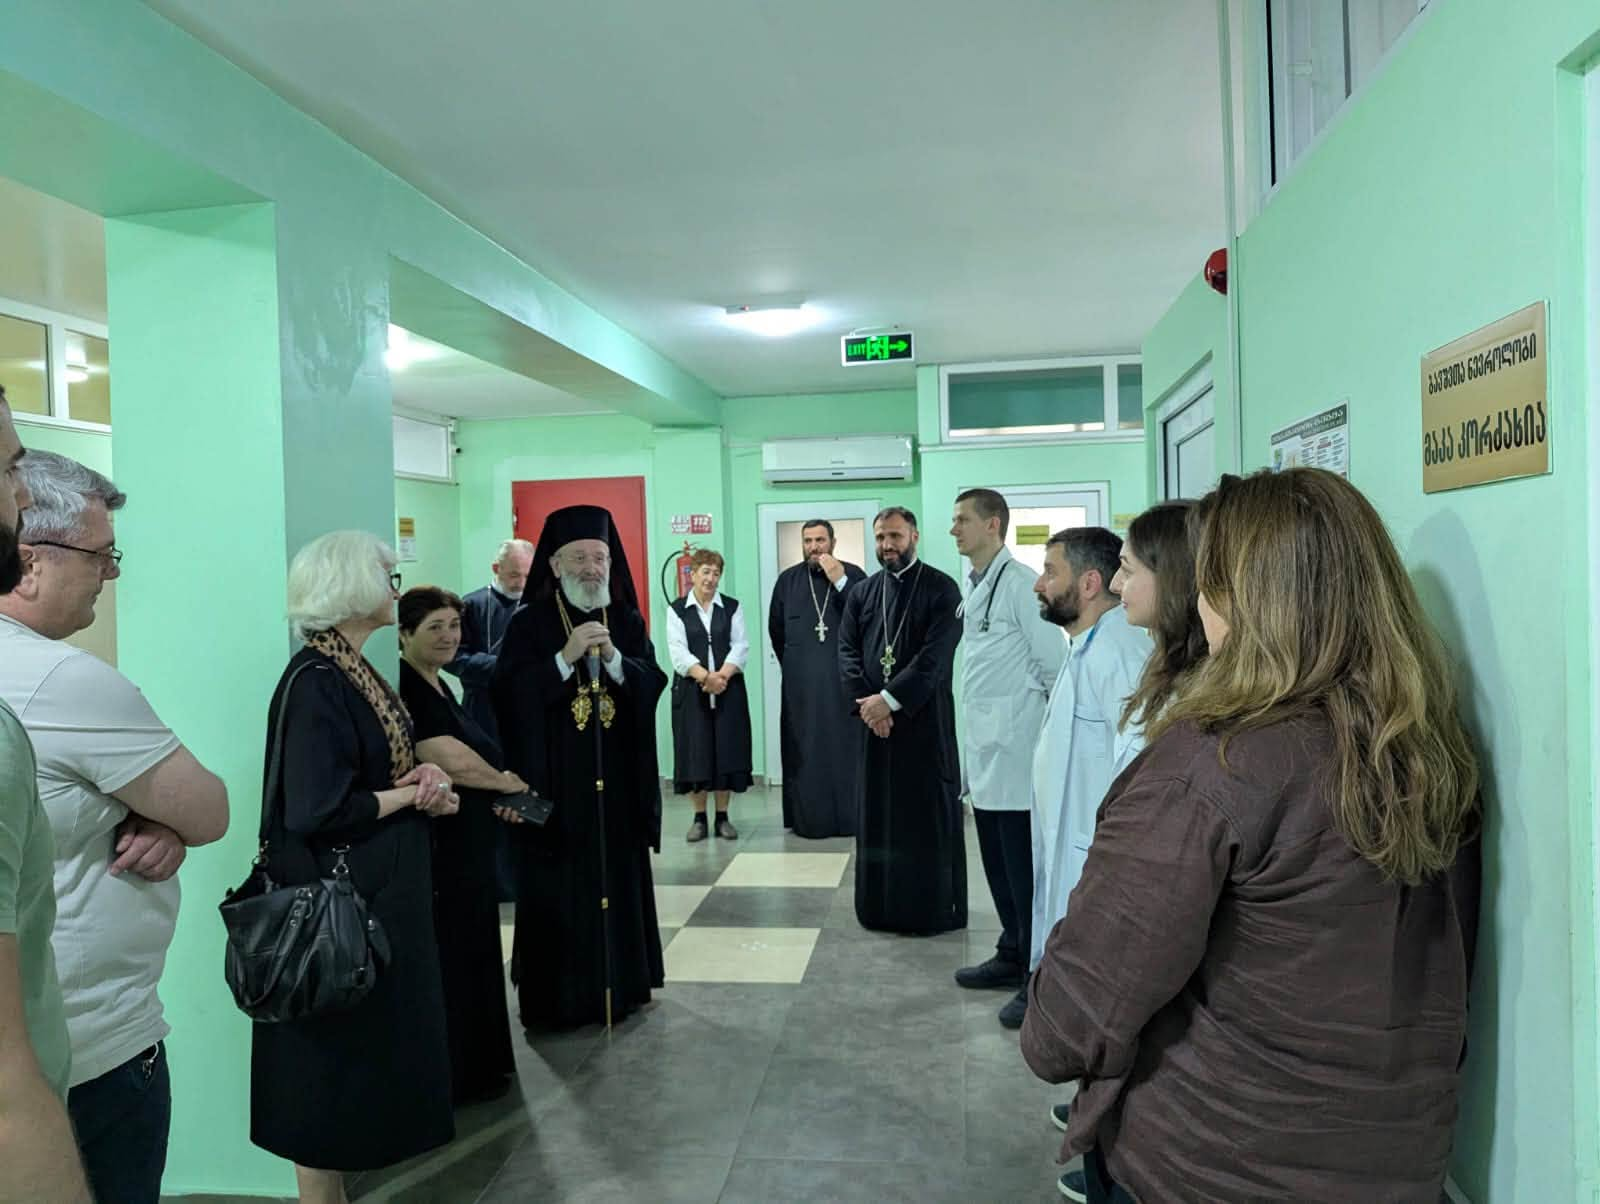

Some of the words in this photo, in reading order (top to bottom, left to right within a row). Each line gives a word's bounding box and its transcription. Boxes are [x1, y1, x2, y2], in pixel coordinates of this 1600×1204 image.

[1428, 362, 1466, 395] ბავშვთა
[1467, 332, 1537, 381] ნევროლოგი
[1424, 426, 1454, 467] მაკა
[1457, 401, 1546, 459] კორძახია
[694, 516, 708, 525] 112
